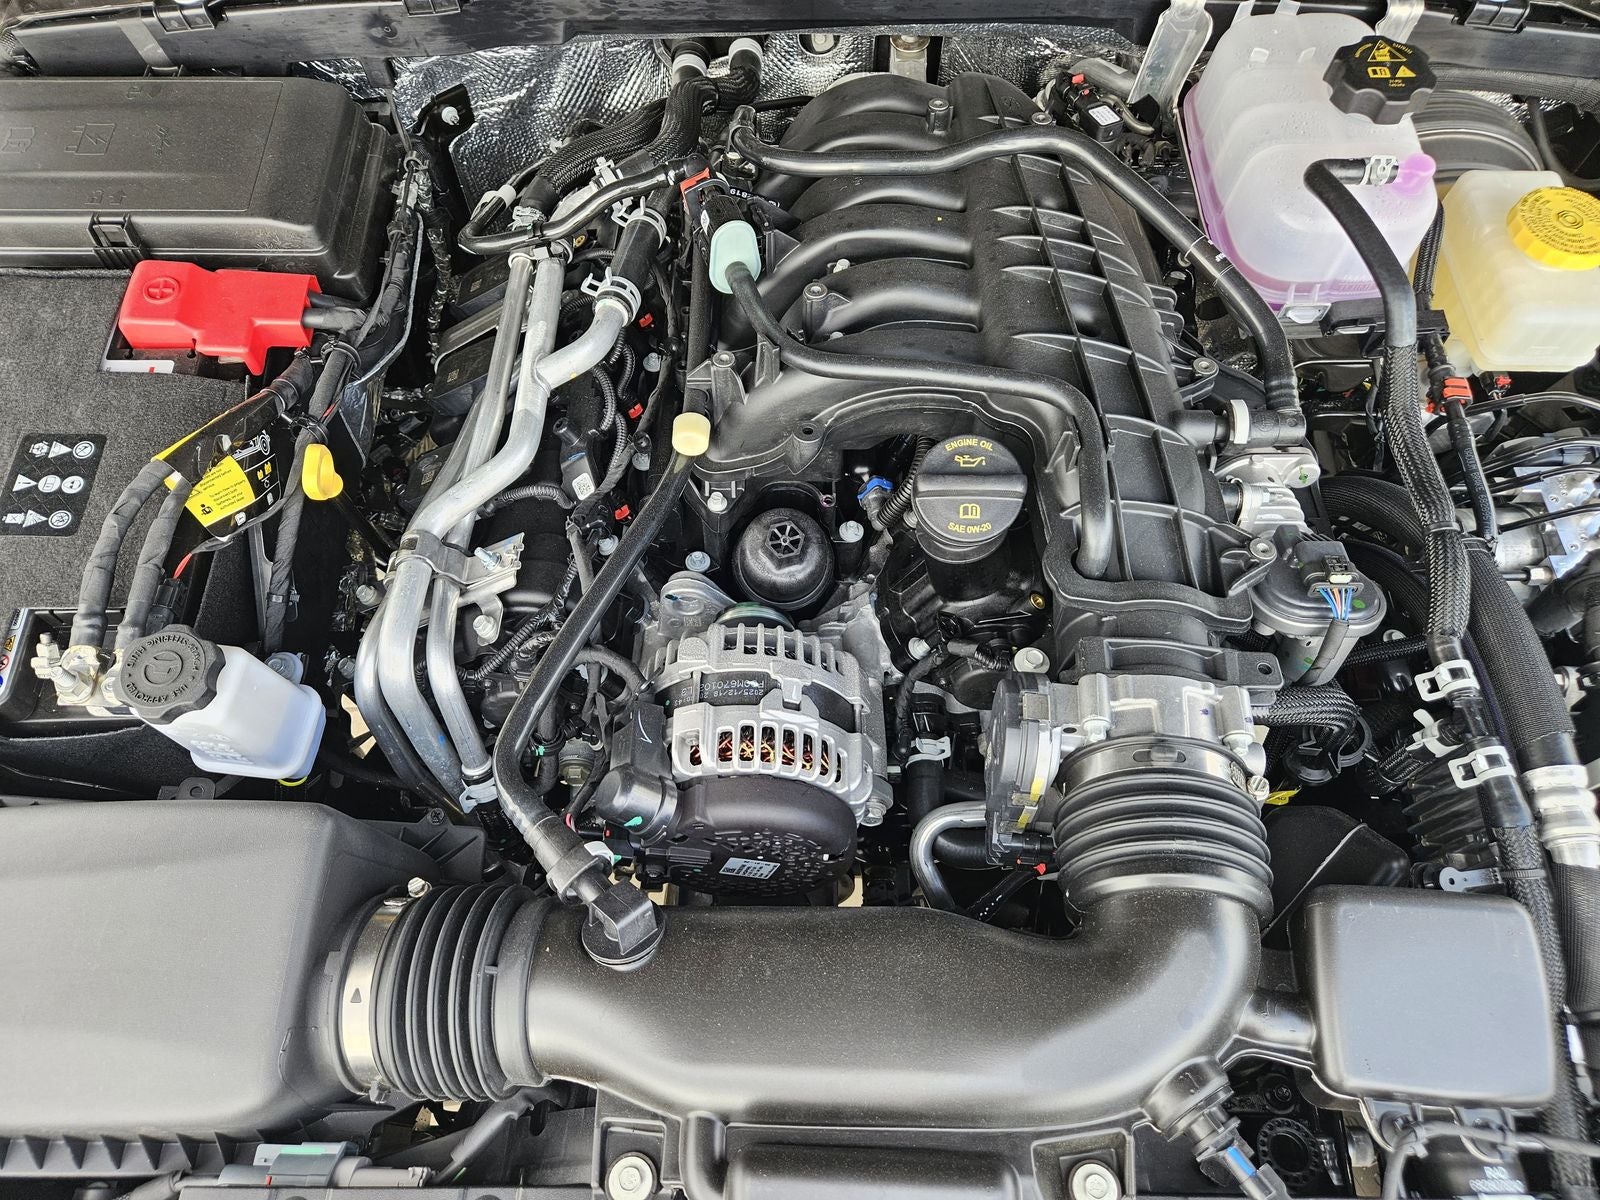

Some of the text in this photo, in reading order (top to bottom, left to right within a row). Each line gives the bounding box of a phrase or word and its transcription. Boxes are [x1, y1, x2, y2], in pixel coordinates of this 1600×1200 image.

[945, 438, 994, 452] ENGINE OIL
[1471, 471, 1485, 492] BRAKE
[947, 522, 992, 534] SAE 0W-20
[146, 634, 190, 647] STEERING
[126, 682, 189, 704] USE APPROVED
[713, 688, 764, 698] 2025/12/18
